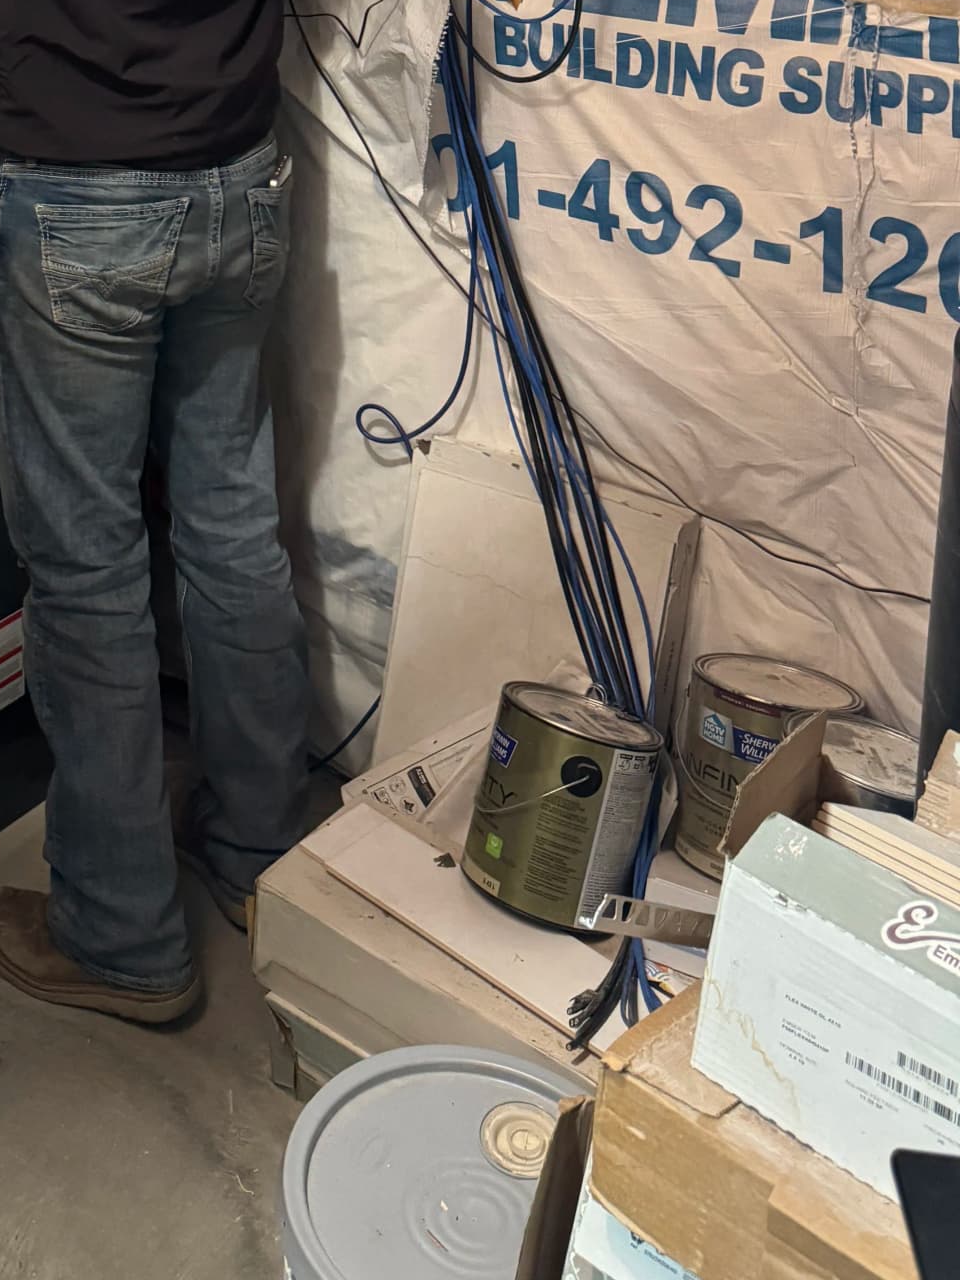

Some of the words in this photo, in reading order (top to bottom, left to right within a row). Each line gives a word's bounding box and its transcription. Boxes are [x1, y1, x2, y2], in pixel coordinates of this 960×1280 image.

[493, 15, 765, 108] BUILDING
[703, 729, 725, 745] HOME
[933, 944, 960, 971] Em
